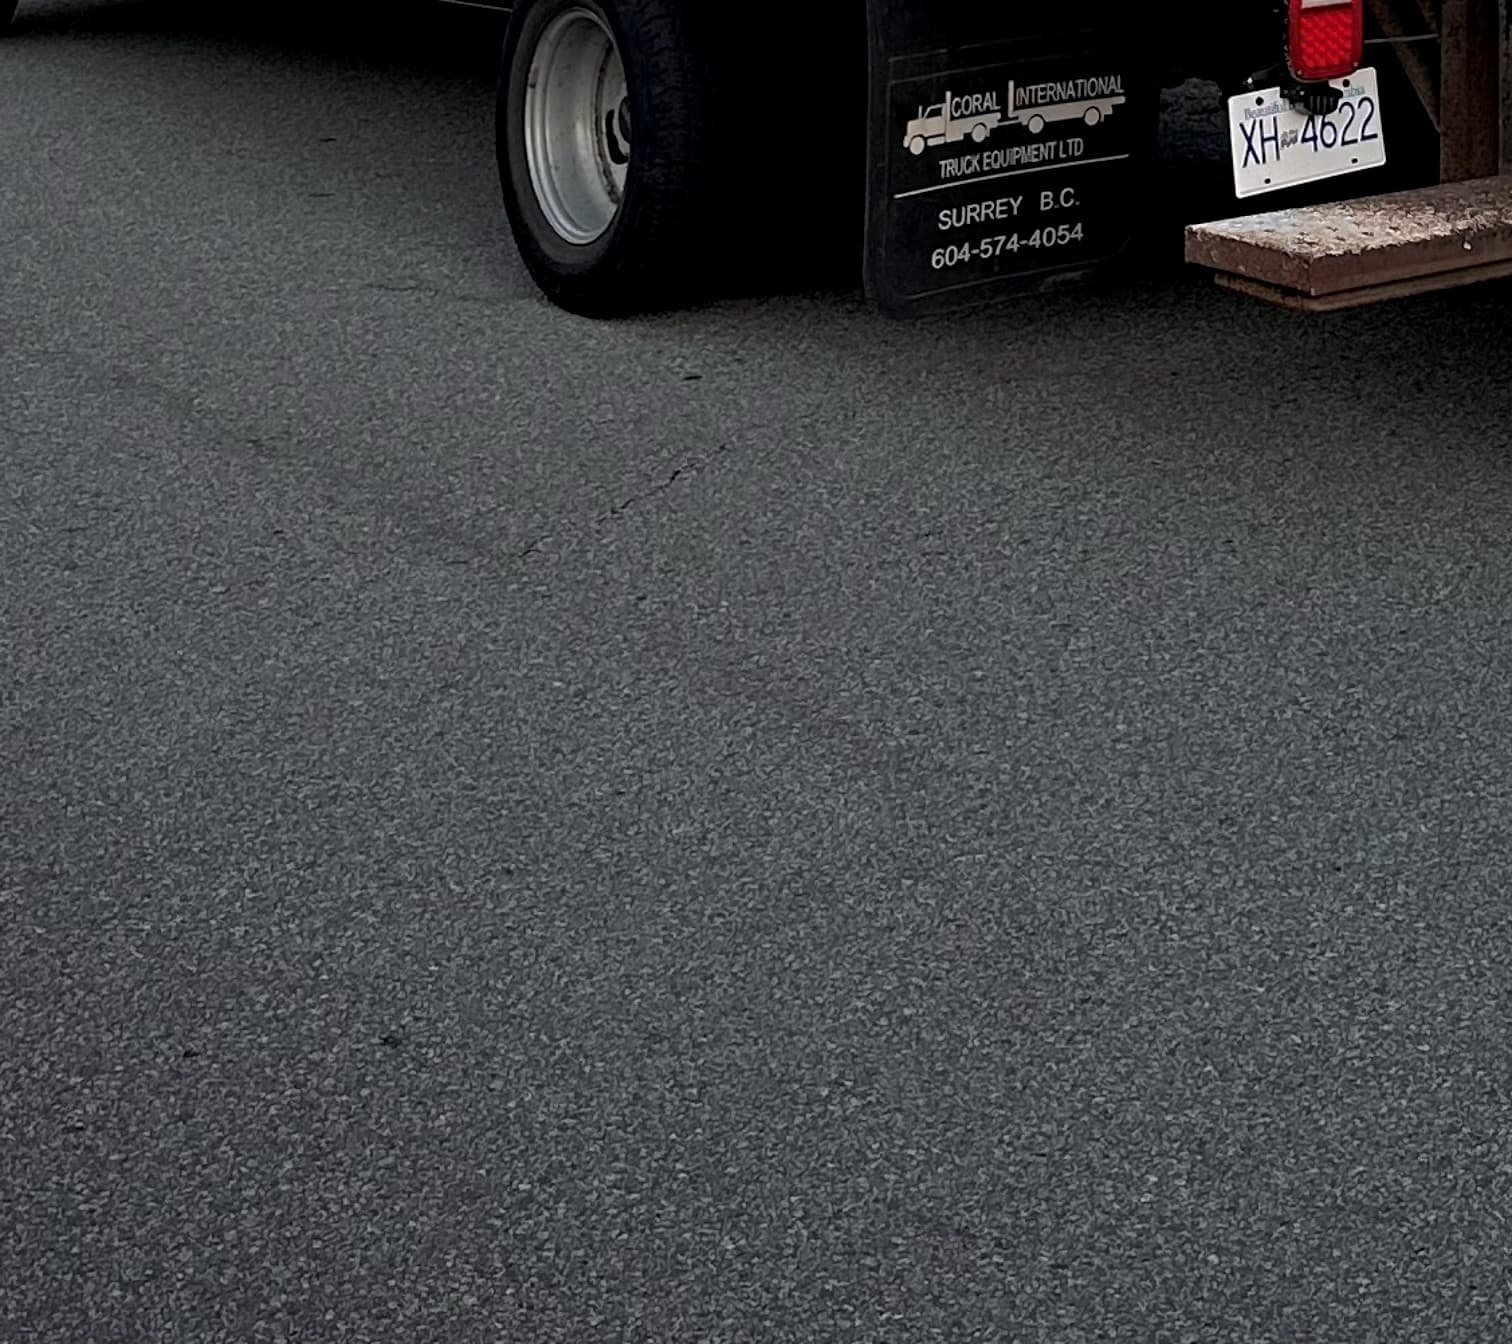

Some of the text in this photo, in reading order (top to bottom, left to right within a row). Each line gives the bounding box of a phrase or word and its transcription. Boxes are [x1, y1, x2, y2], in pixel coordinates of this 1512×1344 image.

[951, 75, 1124, 118] CORAL INTERNATIONAL
[1239, 96, 1378, 168] XH 4622
[940, 138, 1084, 179] TRUCK EQUIPMENT LTD
[938, 188, 1080, 230] SURREY B.C.
[931, 222, 1084, 270] 604-574-4054
